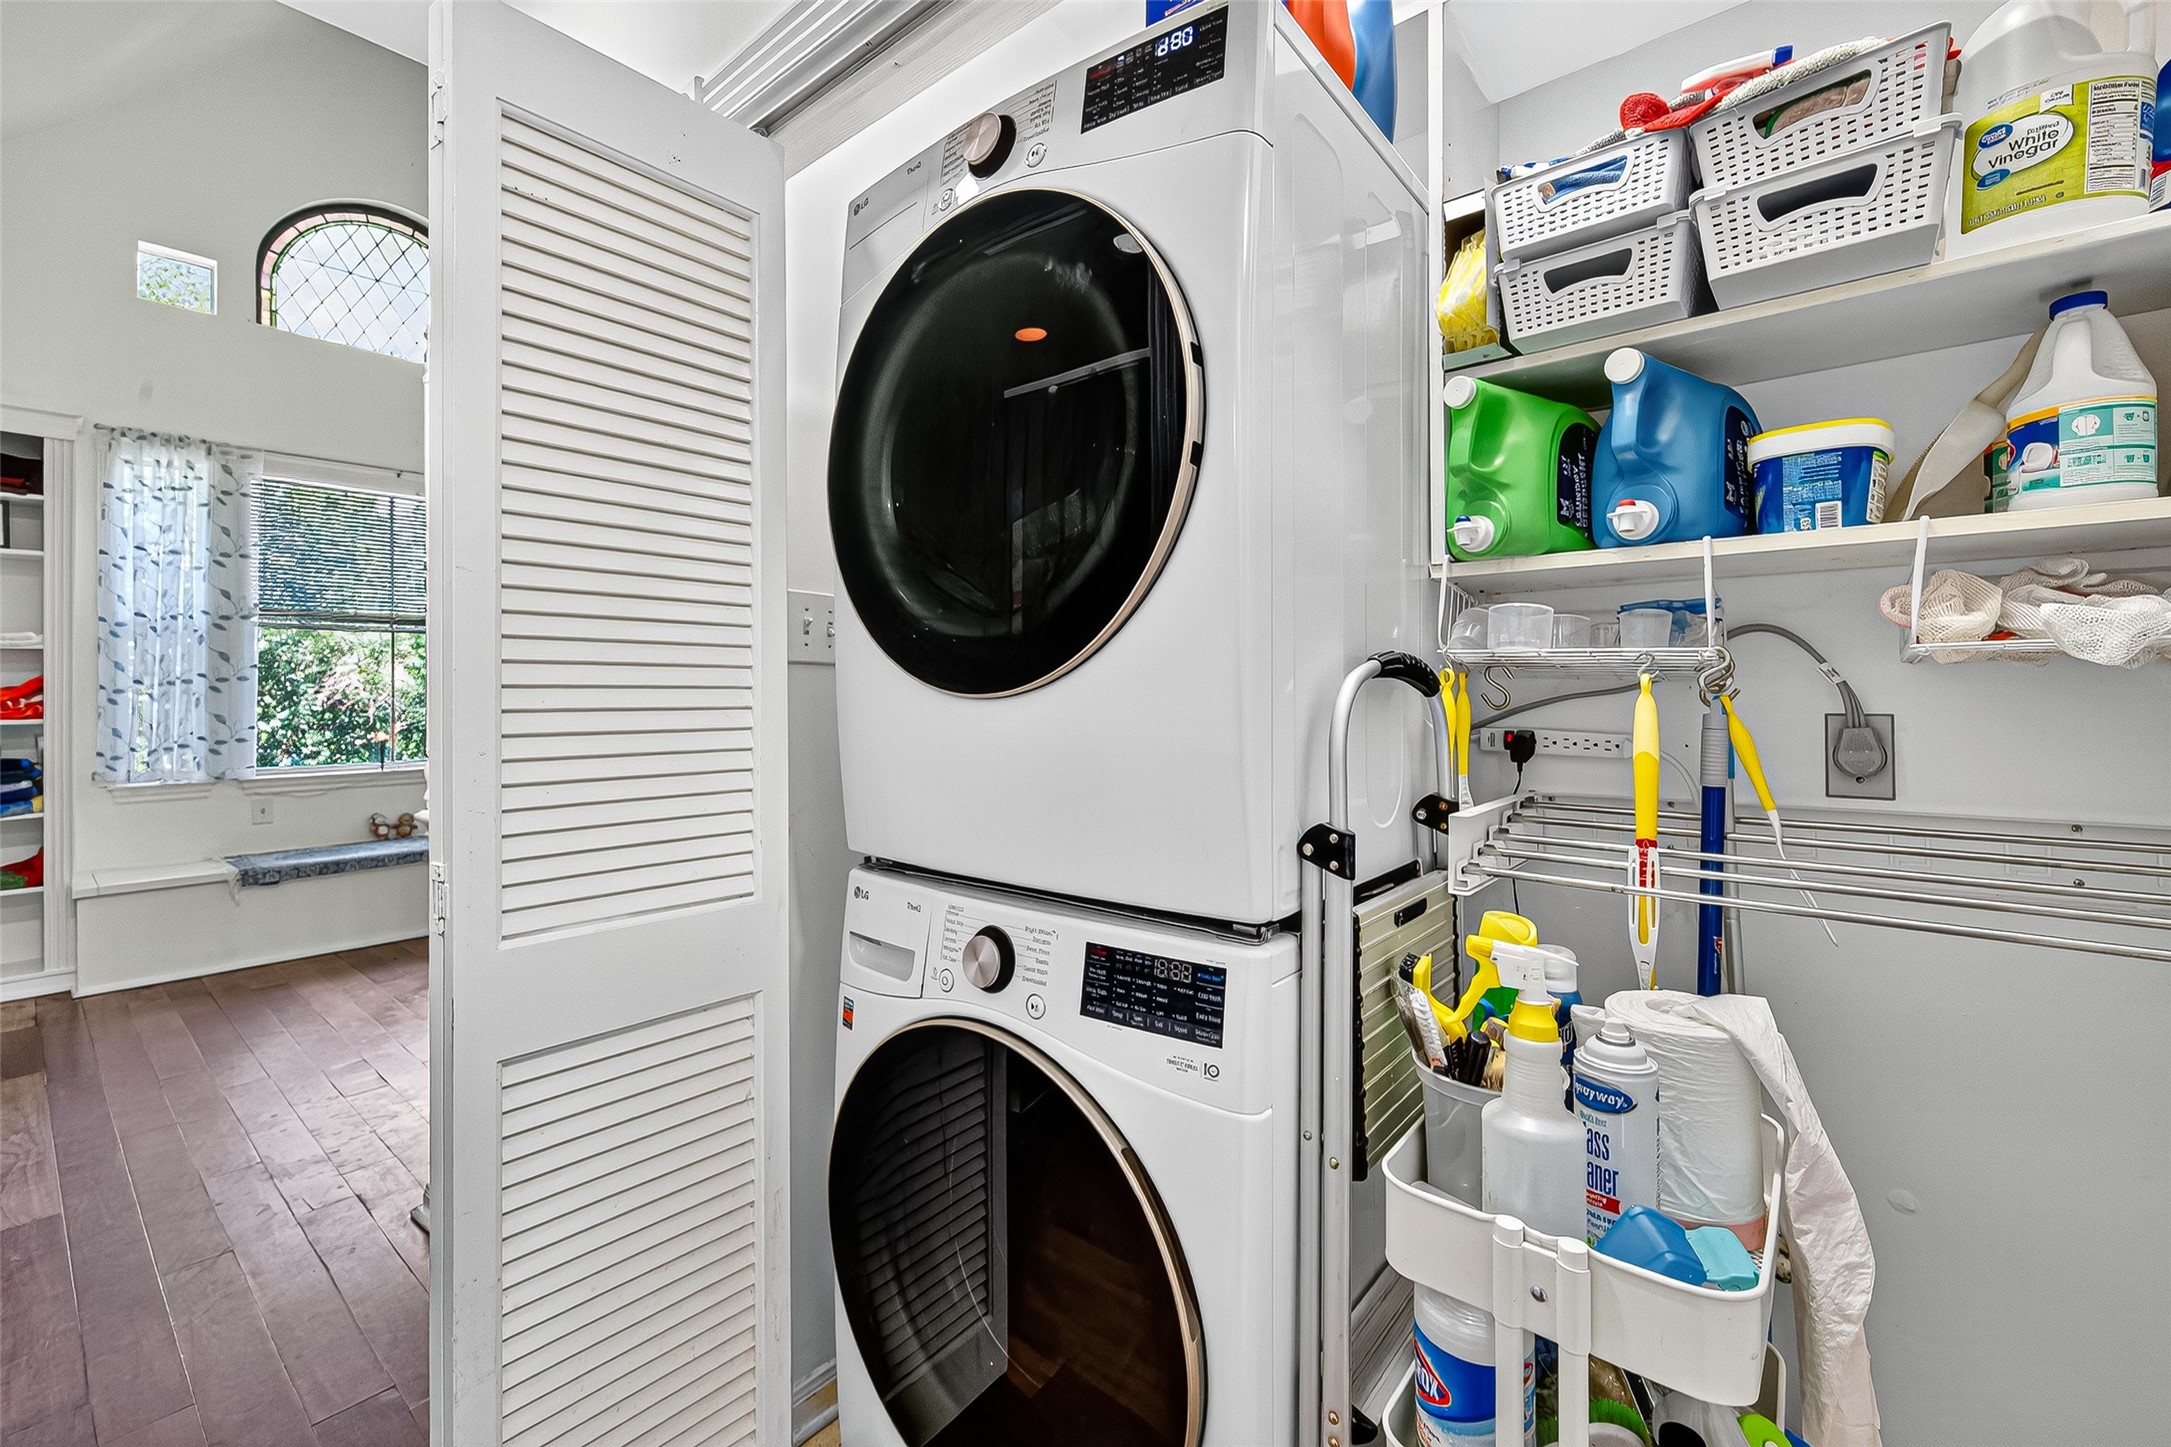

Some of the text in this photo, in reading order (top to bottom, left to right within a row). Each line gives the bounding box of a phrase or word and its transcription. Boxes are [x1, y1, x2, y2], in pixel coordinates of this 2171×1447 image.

[1988, 138, 2059, 169] Vinegar
[2008, 130, 2059, 152] White
[1574, 1082, 1624, 1109] prayway
[1586, 1128, 1610, 1162] ass
[1586, 1161, 1619, 1197] aner
